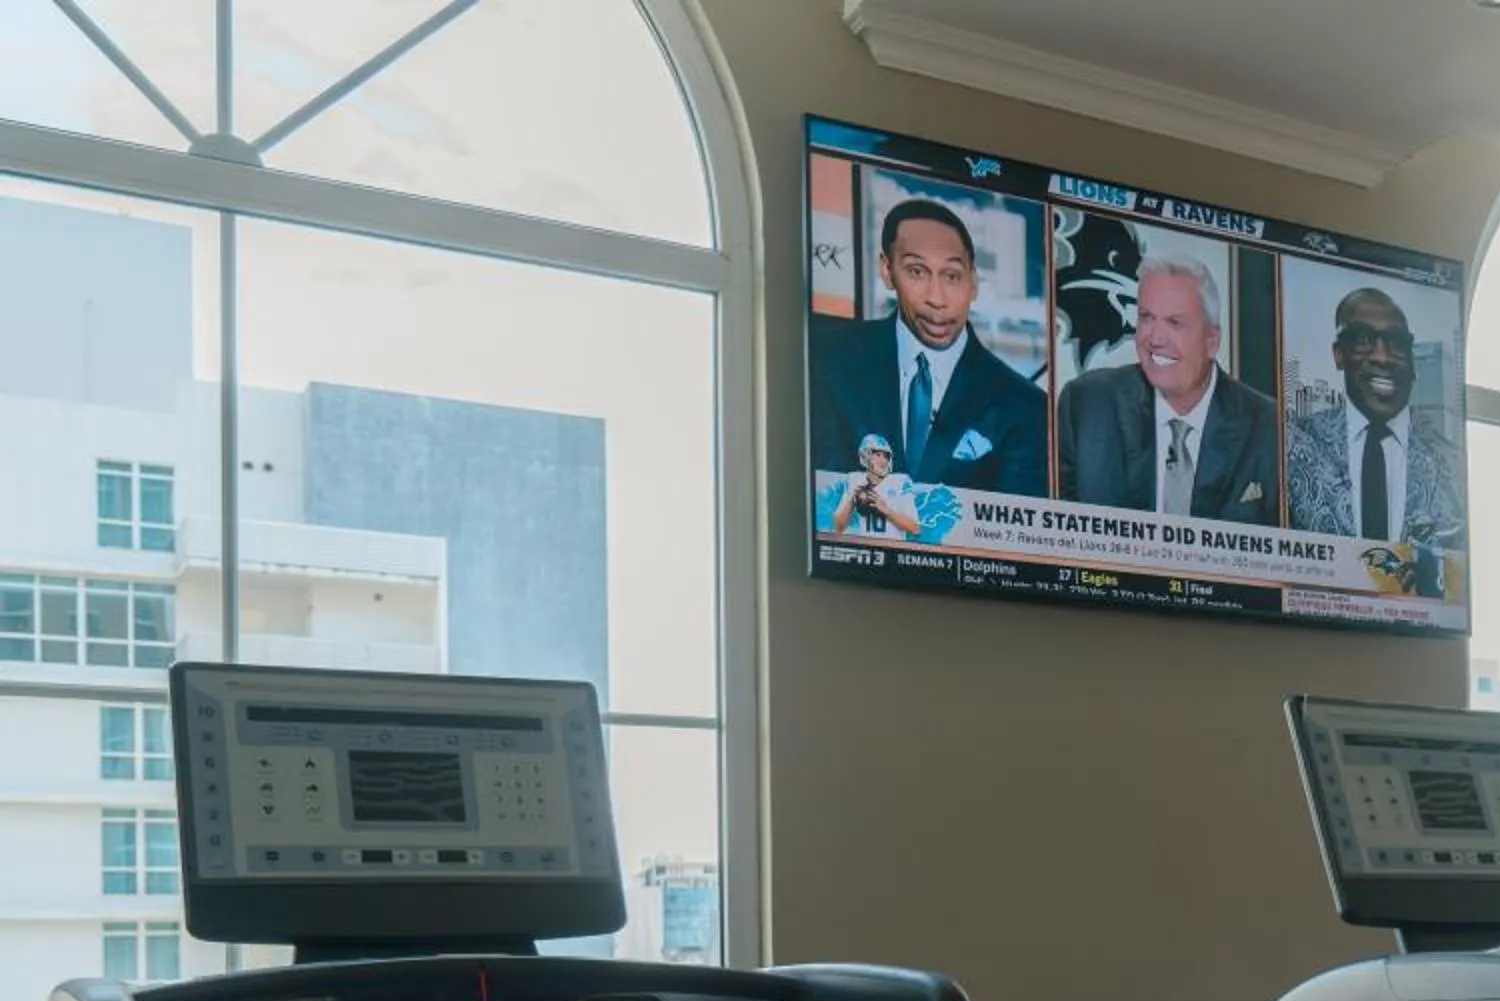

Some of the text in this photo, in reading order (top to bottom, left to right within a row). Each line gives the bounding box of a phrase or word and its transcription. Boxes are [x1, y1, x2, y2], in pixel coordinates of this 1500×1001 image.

[1059, 175, 1258, 235] LIONS AT RAVENS
[974, 502, 1336, 562] WHAT STATEMENT DID RAVENS MAKE?
[974, 527, 1000, 539] Week
[1018, 532, 1055, 548] Ravens
[897, 553, 945, 569] SEMANA
[963, 559, 1017, 576] Dolphins
[1059, 568, 1072, 581] 17
[1081, 571, 1119, 587] Eagles
